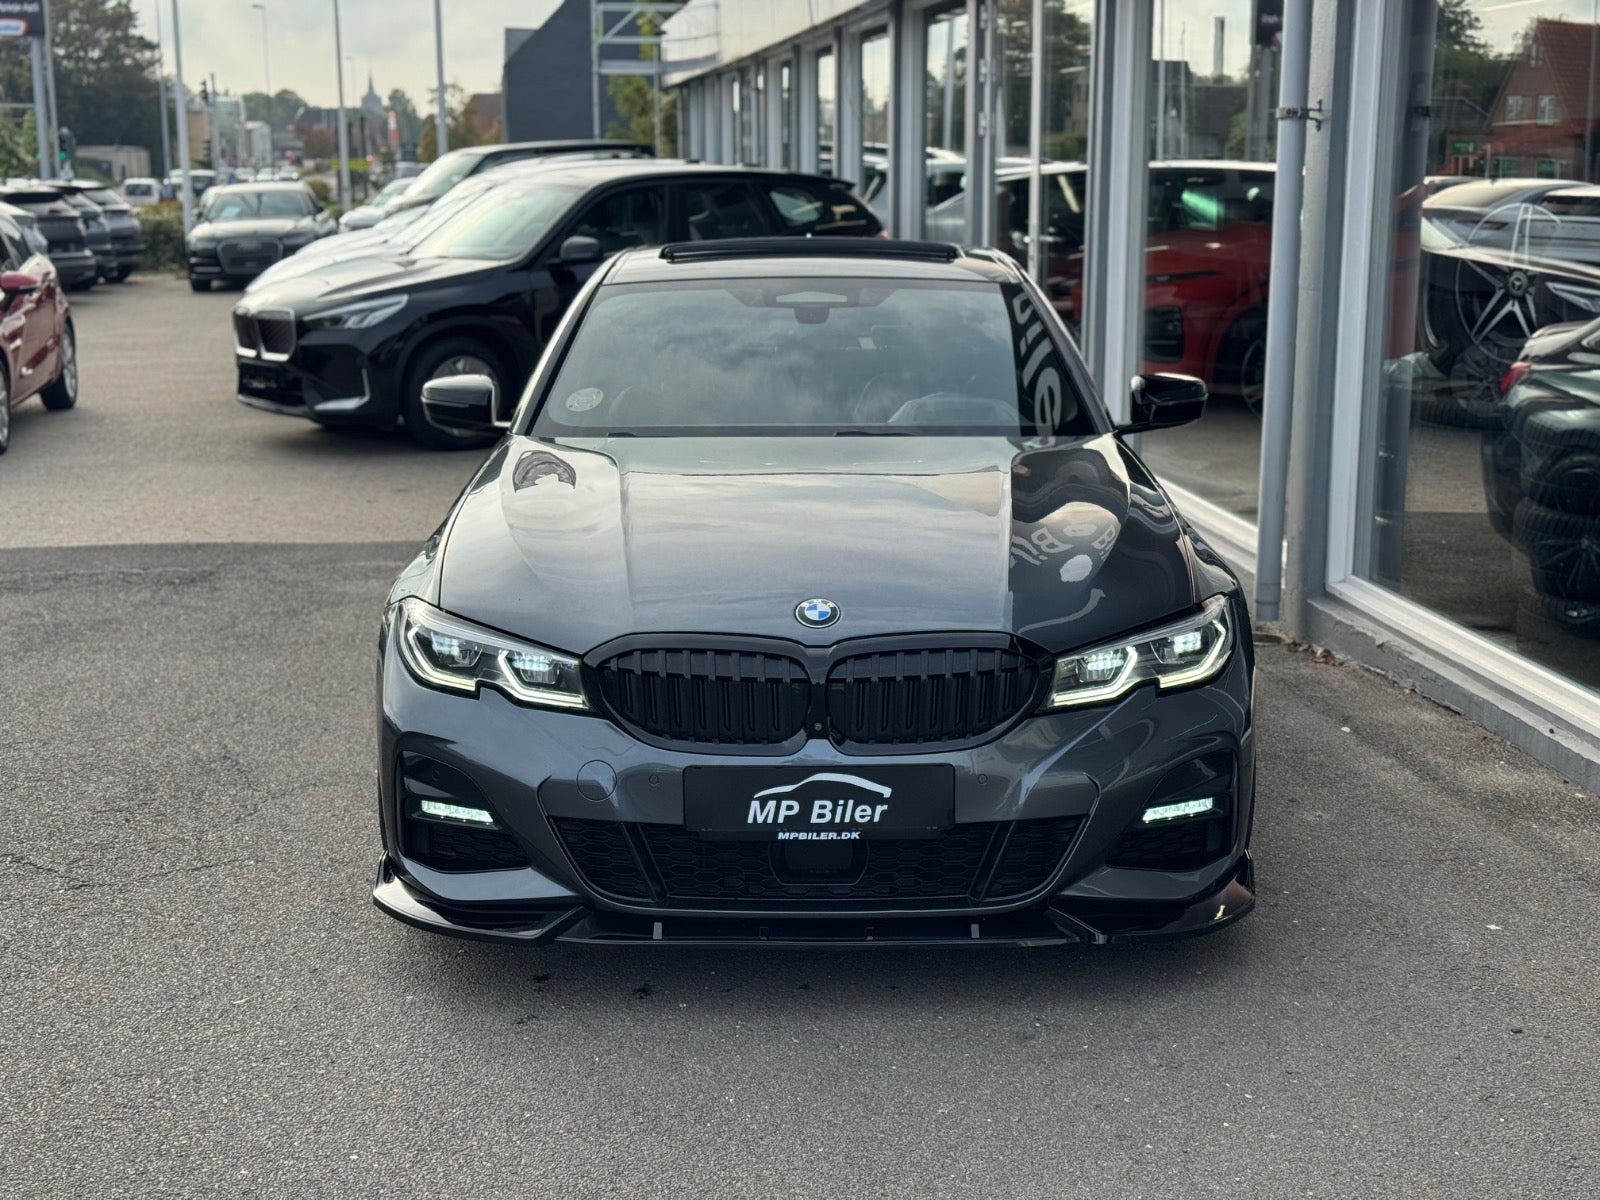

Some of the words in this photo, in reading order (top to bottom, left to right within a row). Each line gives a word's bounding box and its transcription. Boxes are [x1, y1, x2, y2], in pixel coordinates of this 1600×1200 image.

[800, 599, 836, 608] BMW
[747, 800, 800, 823] MP
[810, 800, 888, 823] Biler
[777, 831, 861, 840] MPBILER.DK
